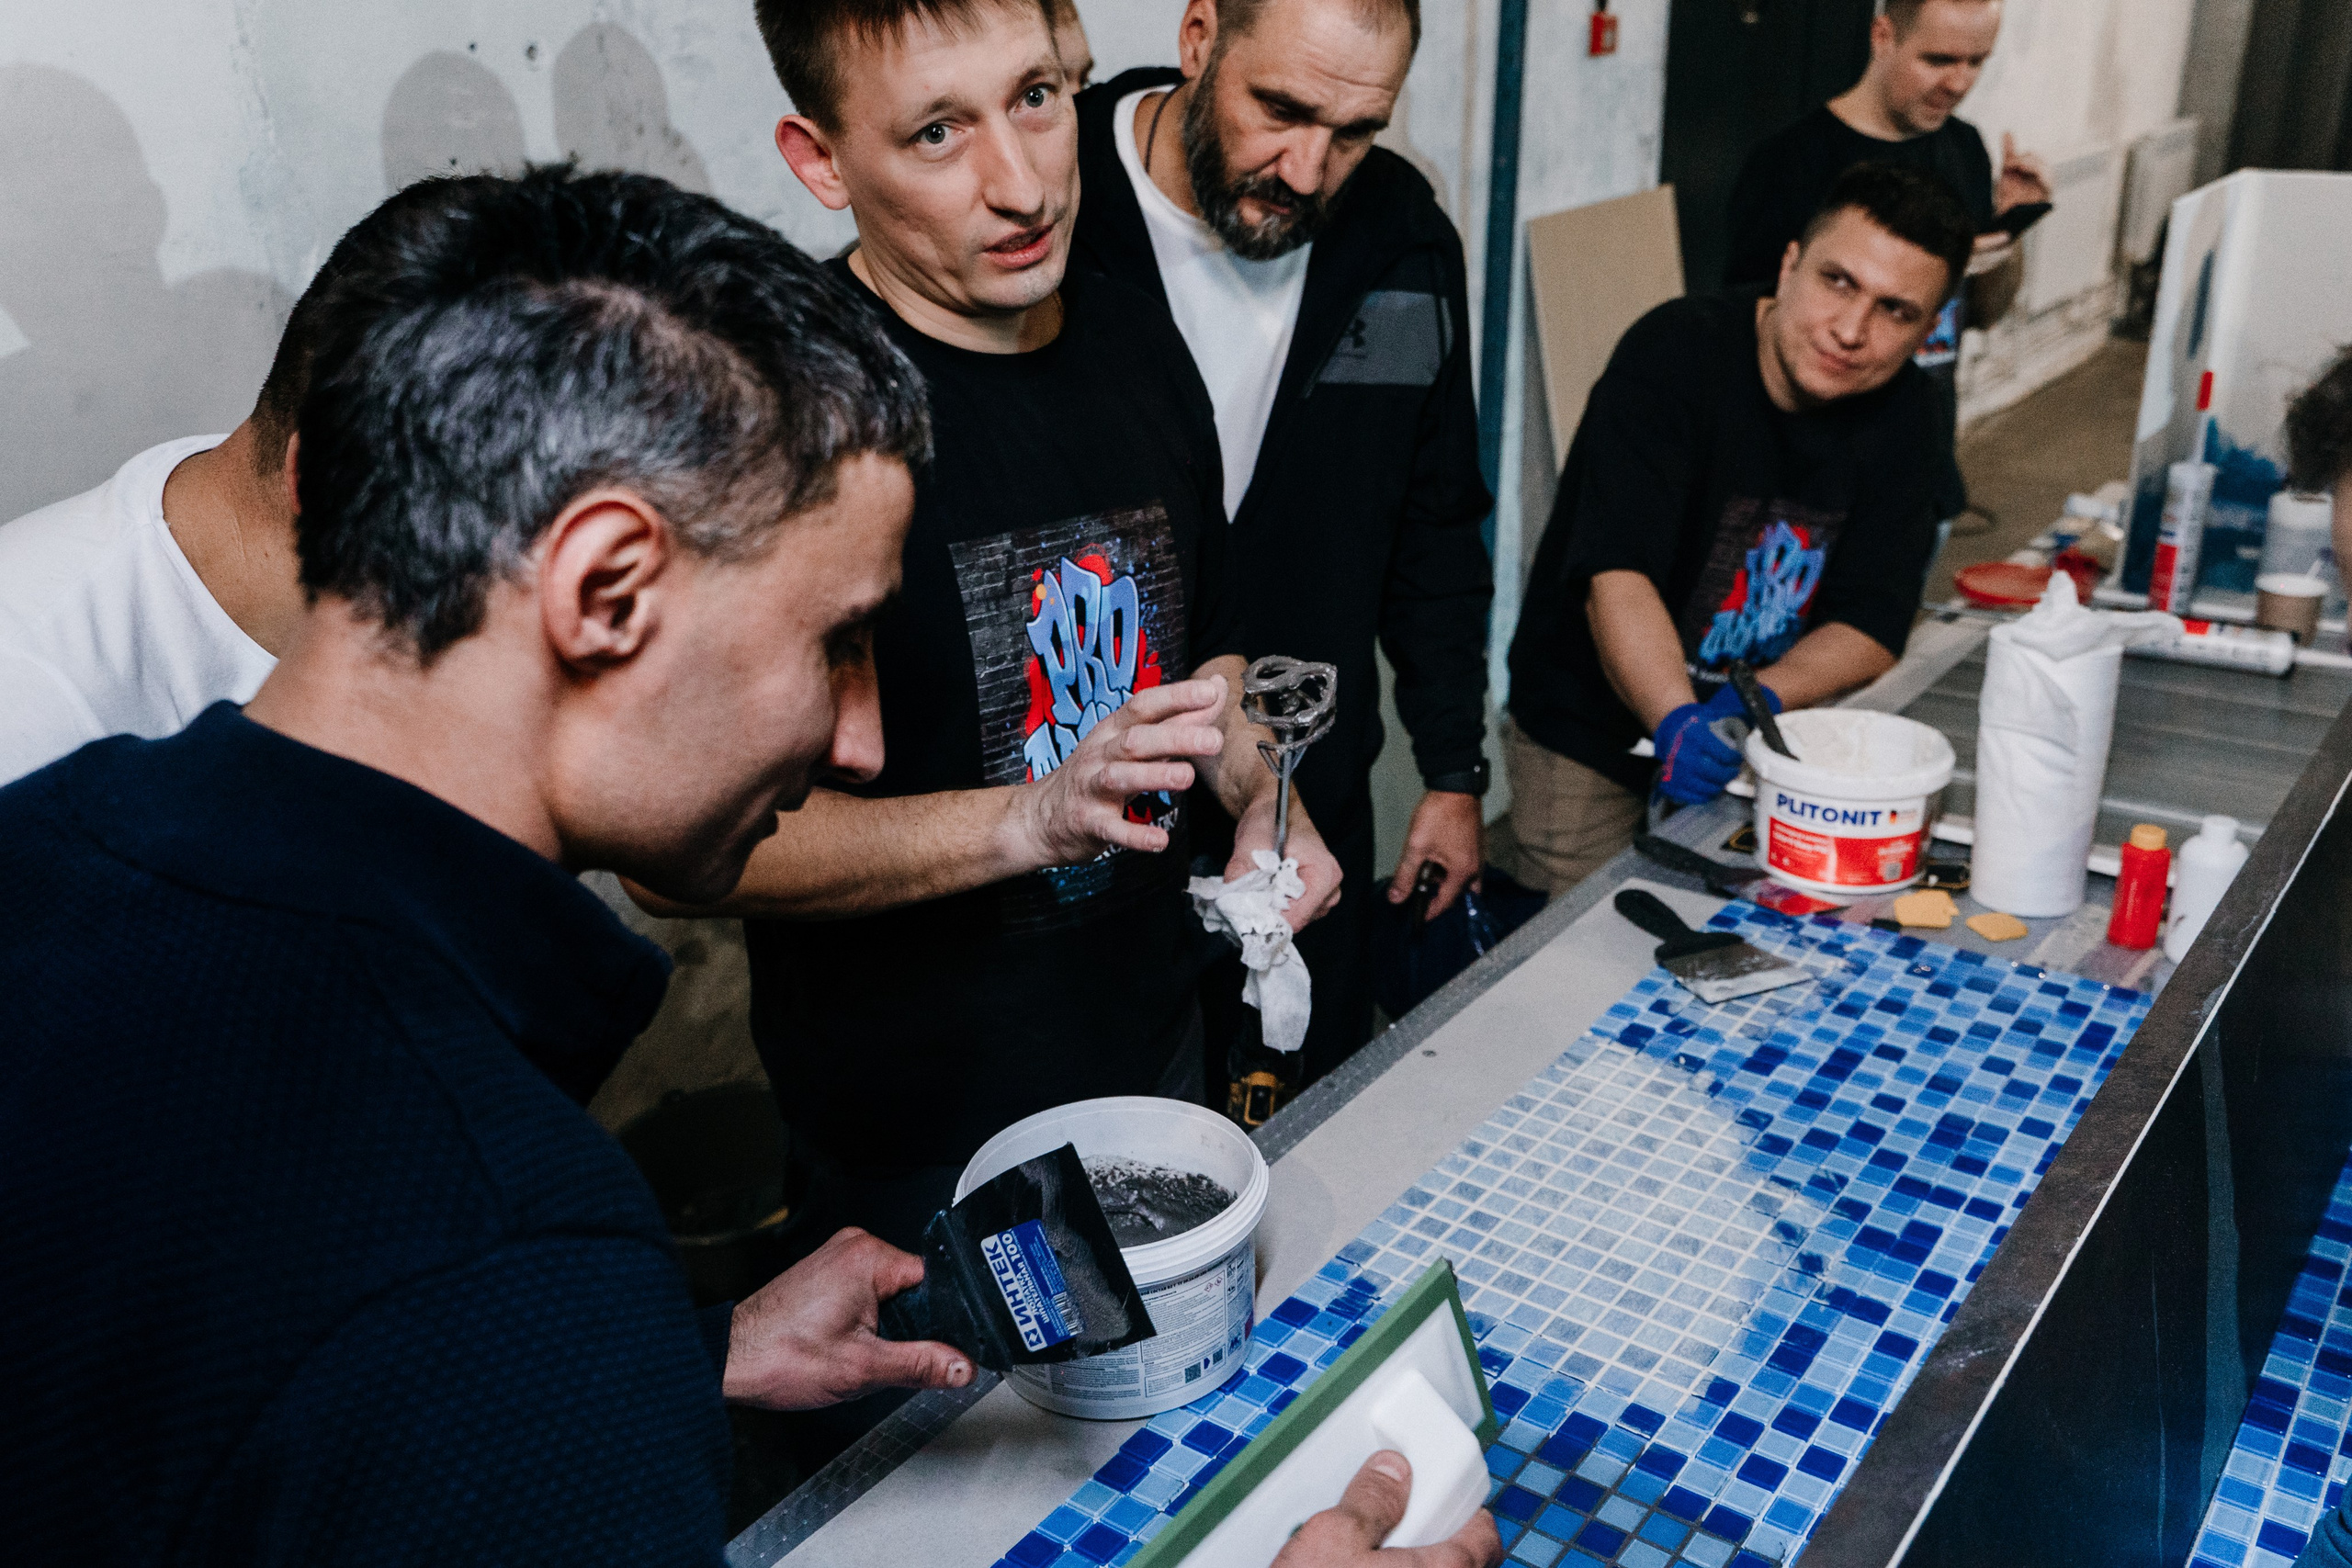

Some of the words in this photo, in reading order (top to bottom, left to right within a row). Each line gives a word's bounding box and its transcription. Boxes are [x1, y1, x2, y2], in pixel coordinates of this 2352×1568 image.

[1025, 557, 1140, 726] PRO
[1777, 793, 1883, 826] PLITONIT
[1001, 1233, 1021, 1262] 100
[985, 1241, 1033, 1325] ИНТЕК
[1017, 1261, 1050, 1324] ШПАТЕЛЬНАЯ
[1017, 1272, 1041, 1315] ЛОПАТКА
